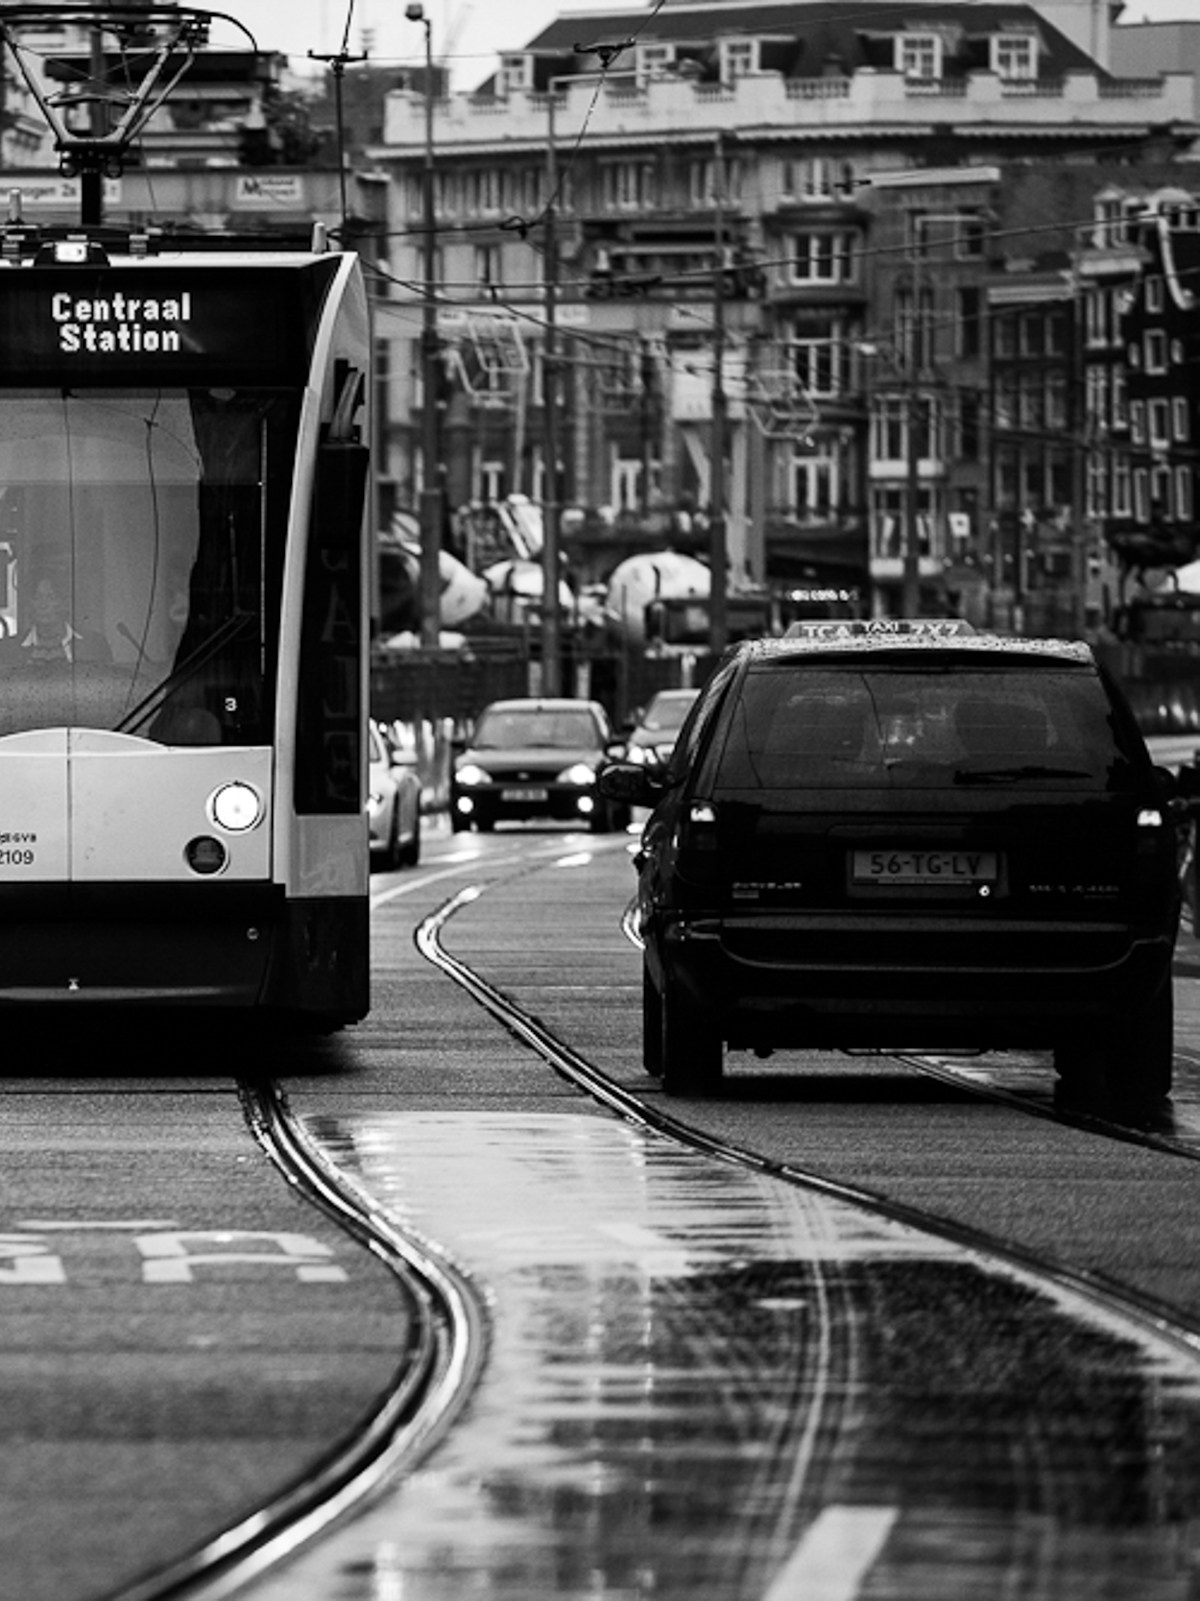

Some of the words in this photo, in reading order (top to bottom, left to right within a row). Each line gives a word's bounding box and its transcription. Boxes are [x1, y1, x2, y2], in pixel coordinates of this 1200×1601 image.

[52, 292, 190, 321] Centraal
[60, 323, 180, 352] Station
[804, 624, 849, 637] TCA
[864, 621, 899, 632] TAXI
[225, 697, 237, 712] 3
[869, 854, 982, 875] 56-TG-LV
